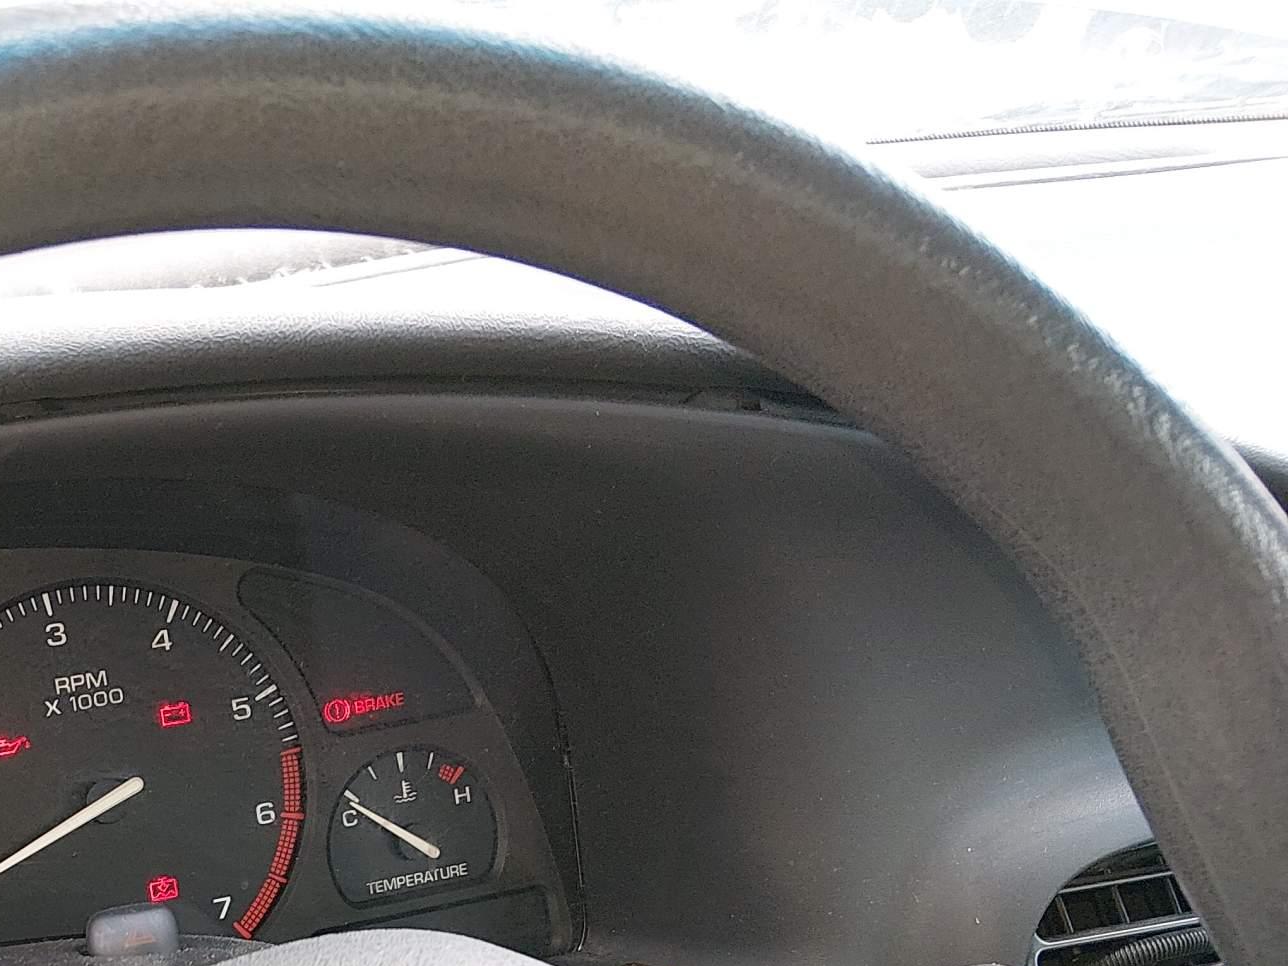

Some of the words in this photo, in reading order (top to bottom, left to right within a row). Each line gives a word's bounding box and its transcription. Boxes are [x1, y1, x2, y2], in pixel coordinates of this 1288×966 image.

[46, 622, 68, 647] 3
[151, 630, 173, 652] 4
[54, 670, 108, 696] RPM
[44, 698, 61, 717] X
[69, 687, 124, 711] 1000
[231, 697, 253, 720] 5
[355, 692, 405, 714] BRAKE
[454, 786, 471, 805] H
[256, 802, 275, 825] 6
[342, 809, 358, 828] C
[366, 863, 469, 895] TEMPERATURE
[212, 897, 232, 919] 7
